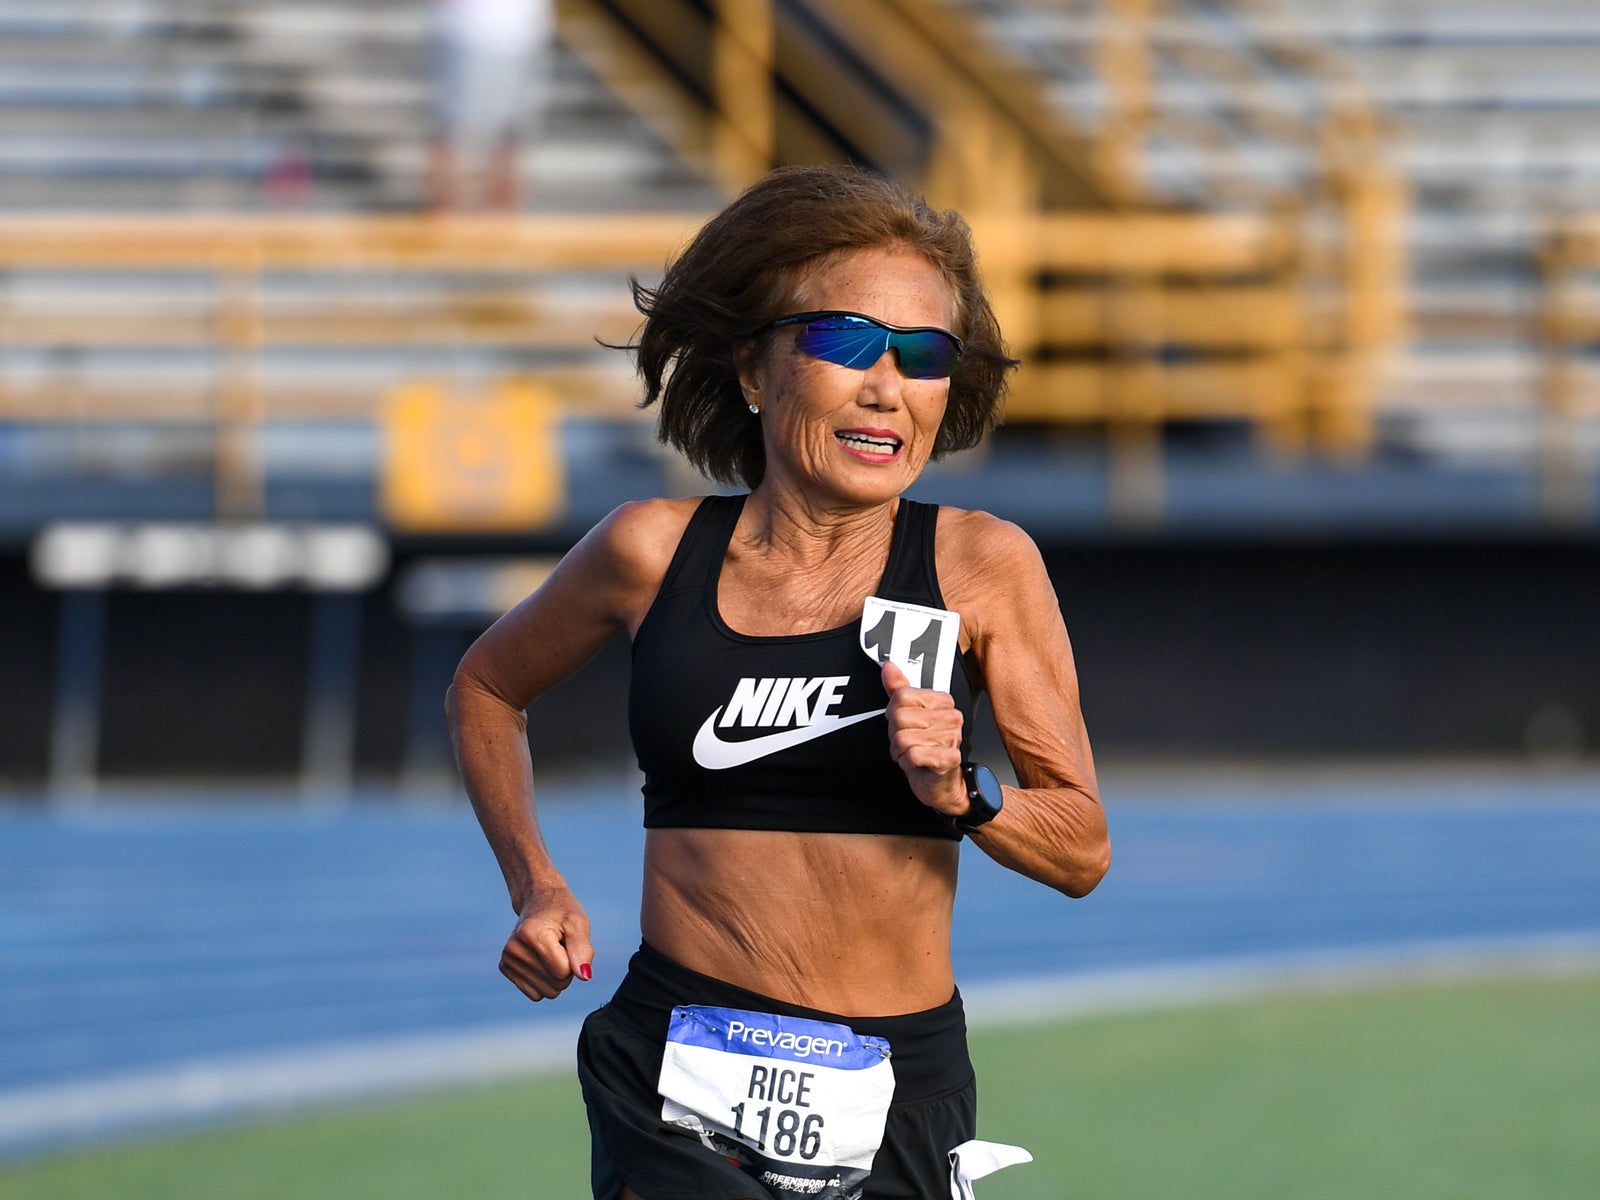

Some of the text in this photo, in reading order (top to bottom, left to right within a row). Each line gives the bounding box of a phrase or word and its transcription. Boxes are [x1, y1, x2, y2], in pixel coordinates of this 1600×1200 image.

[718, 675, 851, 728] NIKE
[727, 1021, 844, 1058] Prevagen
[747, 1064, 815, 1108] RICE
[731, 1102, 824, 1160] 1186
[764, 1170, 826, 1188] GREENSBORO
